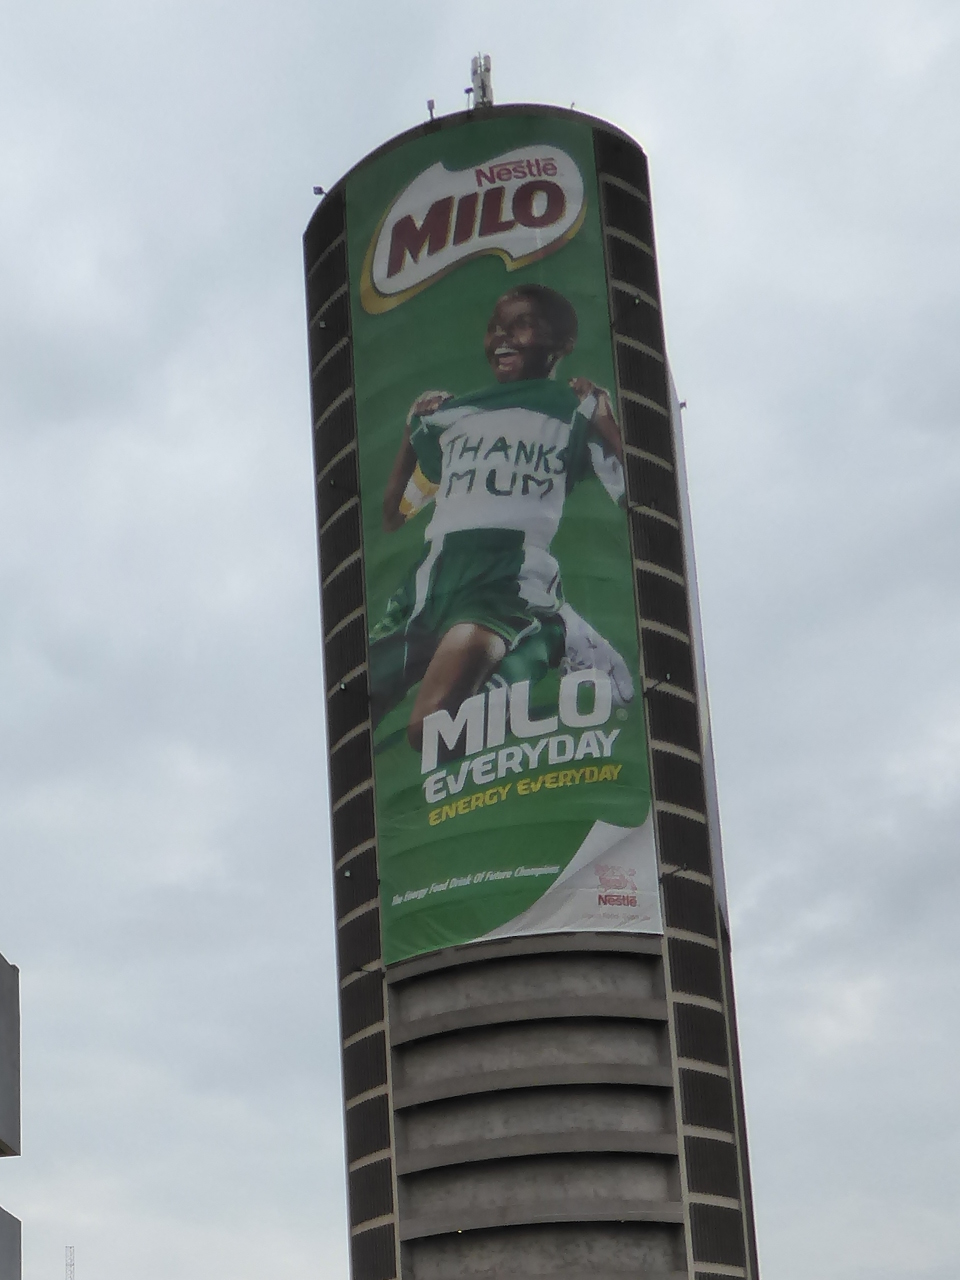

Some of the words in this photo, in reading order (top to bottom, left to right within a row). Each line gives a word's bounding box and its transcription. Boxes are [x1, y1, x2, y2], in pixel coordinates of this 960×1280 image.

[386, 178, 567, 279] MILO
[445, 433, 569, 474] THANKS
[445, 471, 555, 500] MUM
[421, 668, 613, 775] MILO
[422, 728, 622, 804] EVERYDAY
[428, 782, 513, 827] ENERGY
[517, 764, 623, 797] EVERYDAY
[428, 879, 450, 894] Food
[449, 873, 473, 889] Drink
[473, 871, 486, 884] Of
[485, 870, 513, 882] Future
